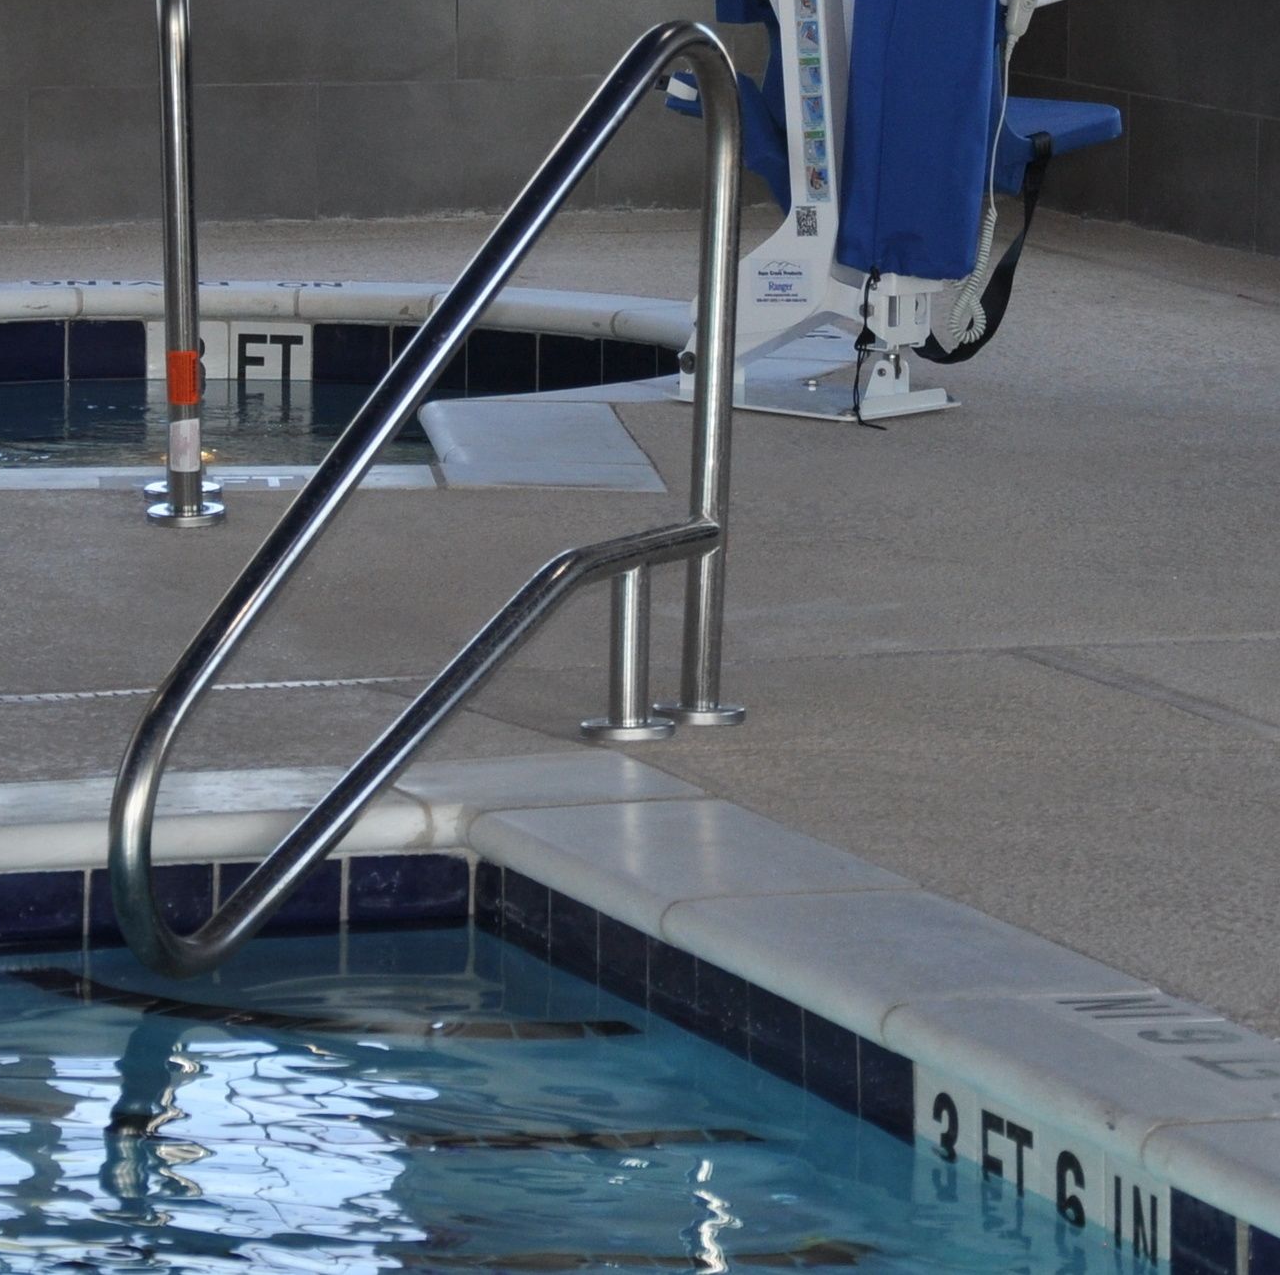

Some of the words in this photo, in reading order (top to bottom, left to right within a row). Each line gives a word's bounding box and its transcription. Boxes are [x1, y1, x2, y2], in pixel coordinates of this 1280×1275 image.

[768, 281, 793, 292] Ranger
[238, 333, 304, 384] FT
[932, 1092, 958, 1164] 3
[981, 1109, 1033, 1198] FT
[1056, 1150, 1085, 1229] 6
[1114, 1175, 1158, 1267] IN
